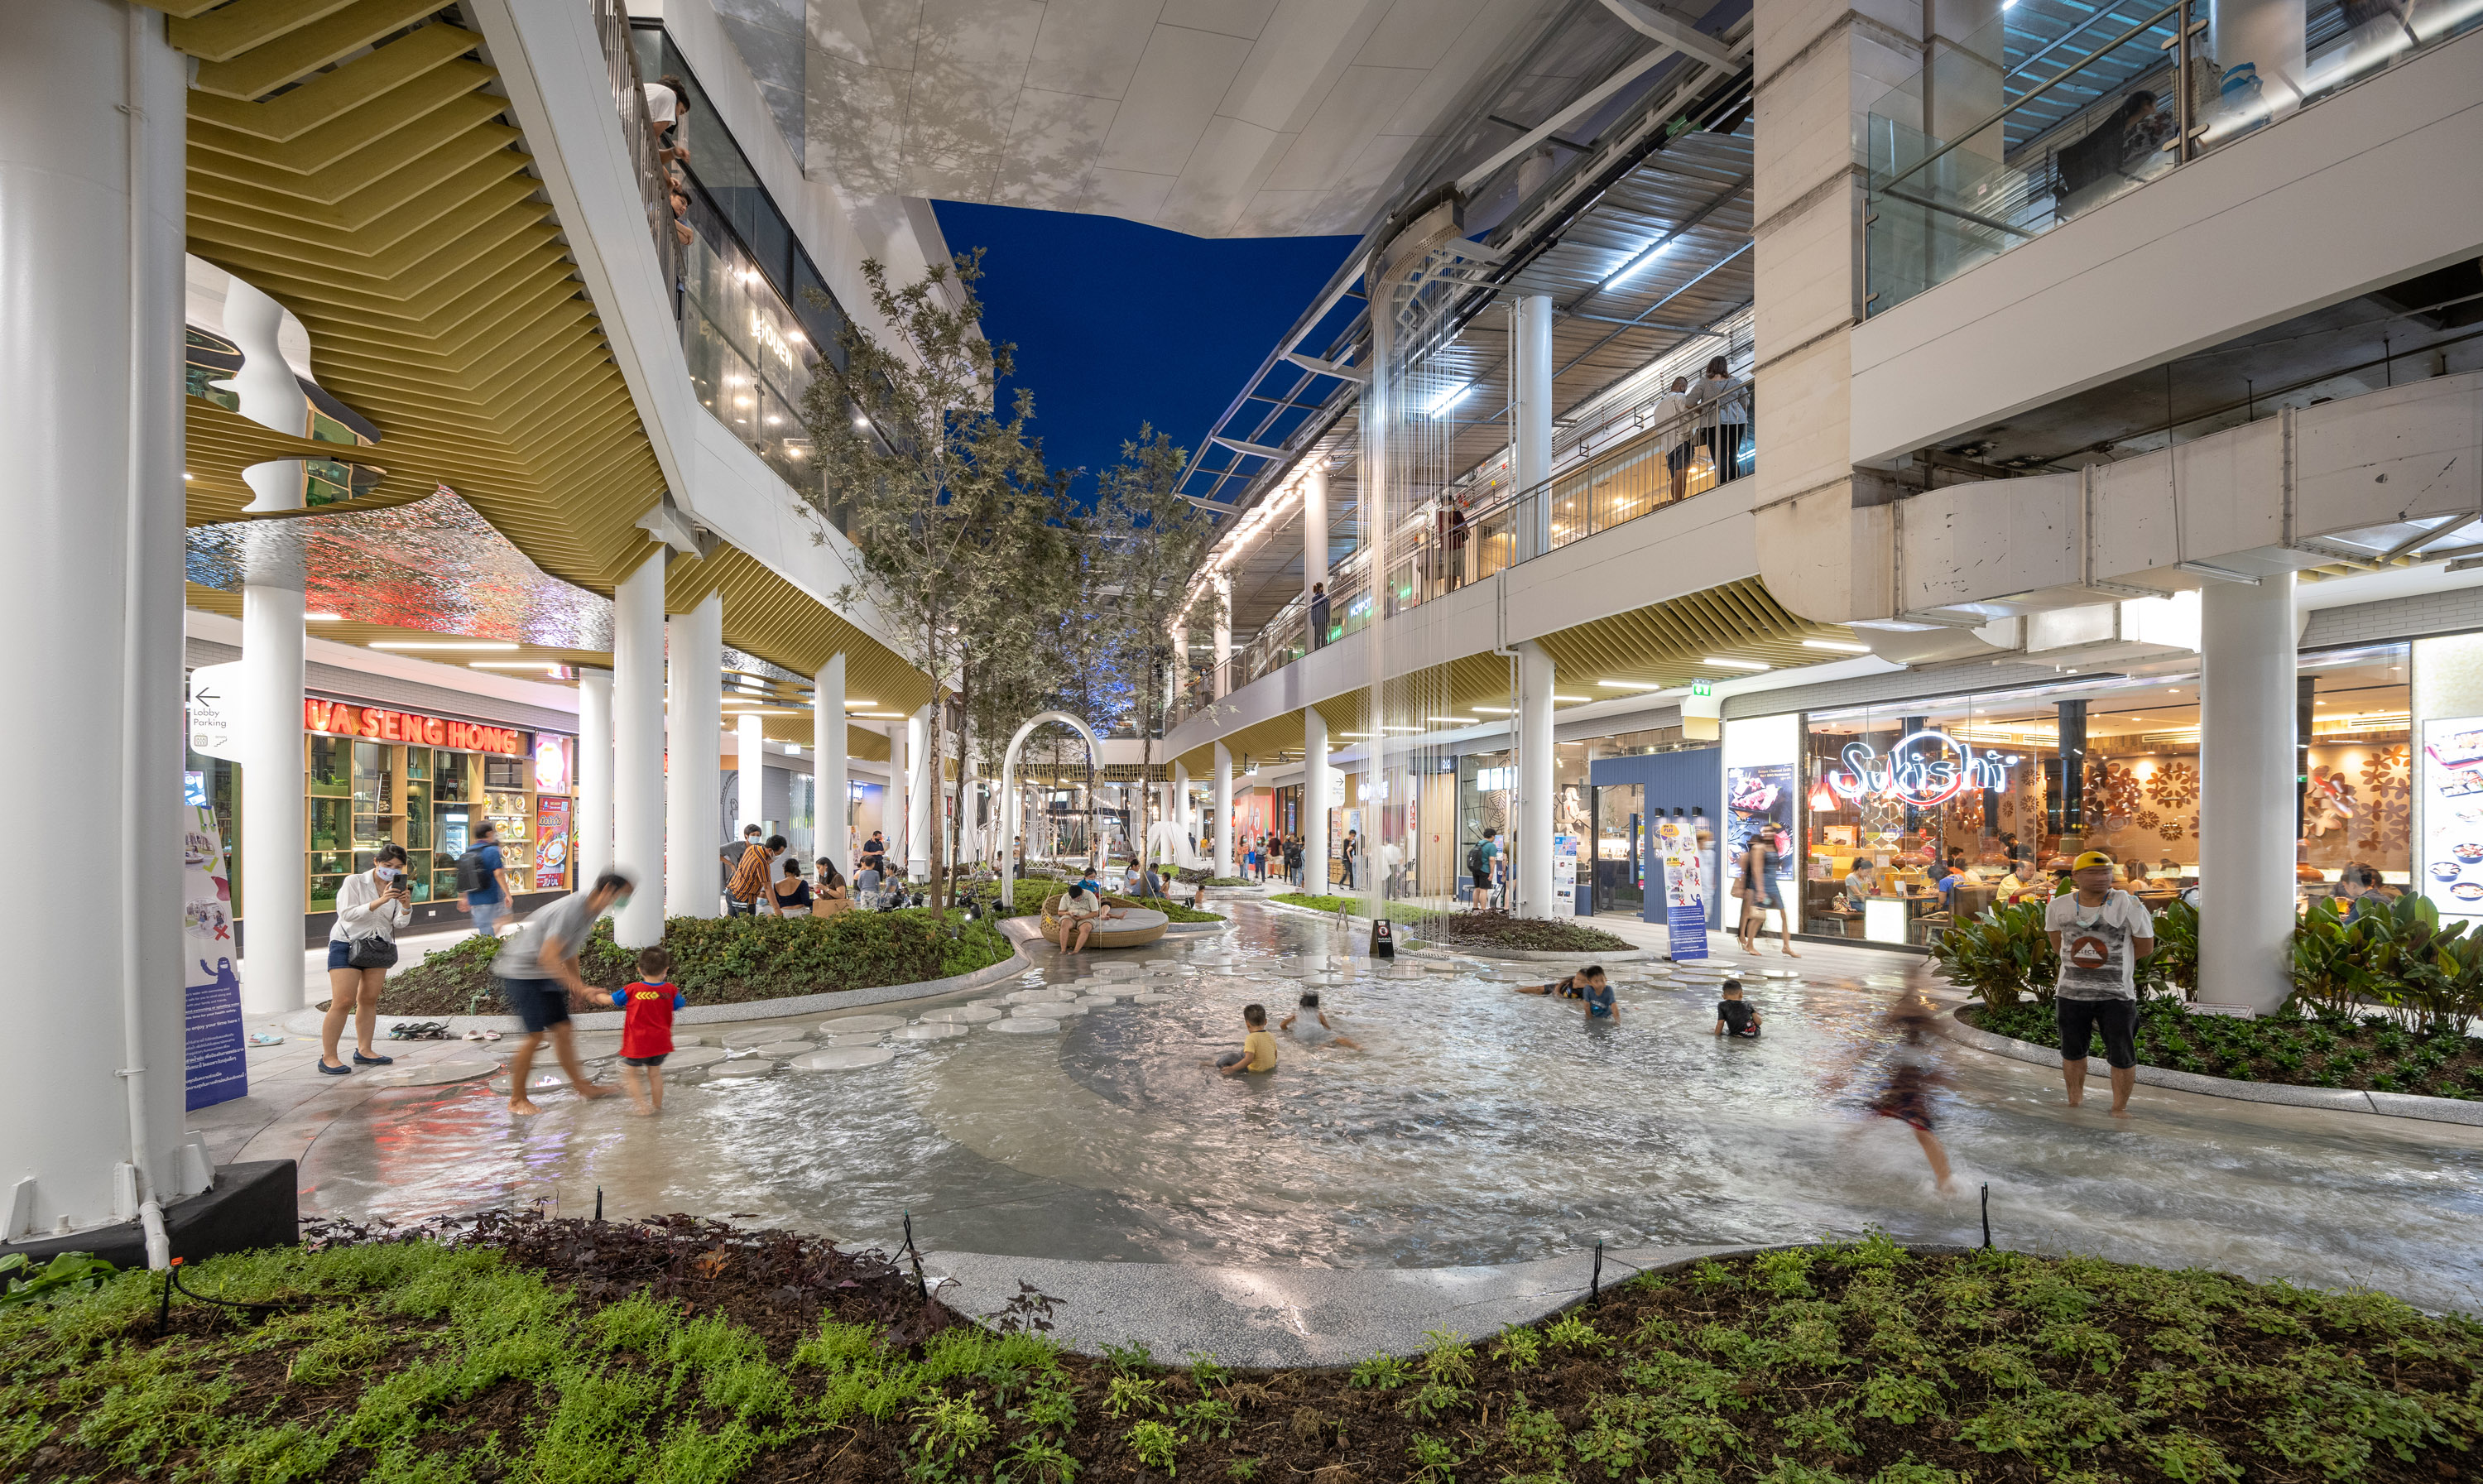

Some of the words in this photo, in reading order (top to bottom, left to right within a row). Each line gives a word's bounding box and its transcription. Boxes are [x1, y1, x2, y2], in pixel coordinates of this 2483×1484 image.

[194, 708, 219, 718] Lobby
[194, 718, 227, 728] Parking
[305, 699, 353, 735] UA
[361, 708, 443, 745] SENG
[448, 722, 517, 754] HONG
[1829, 742, 2005, 799] Sukishi
